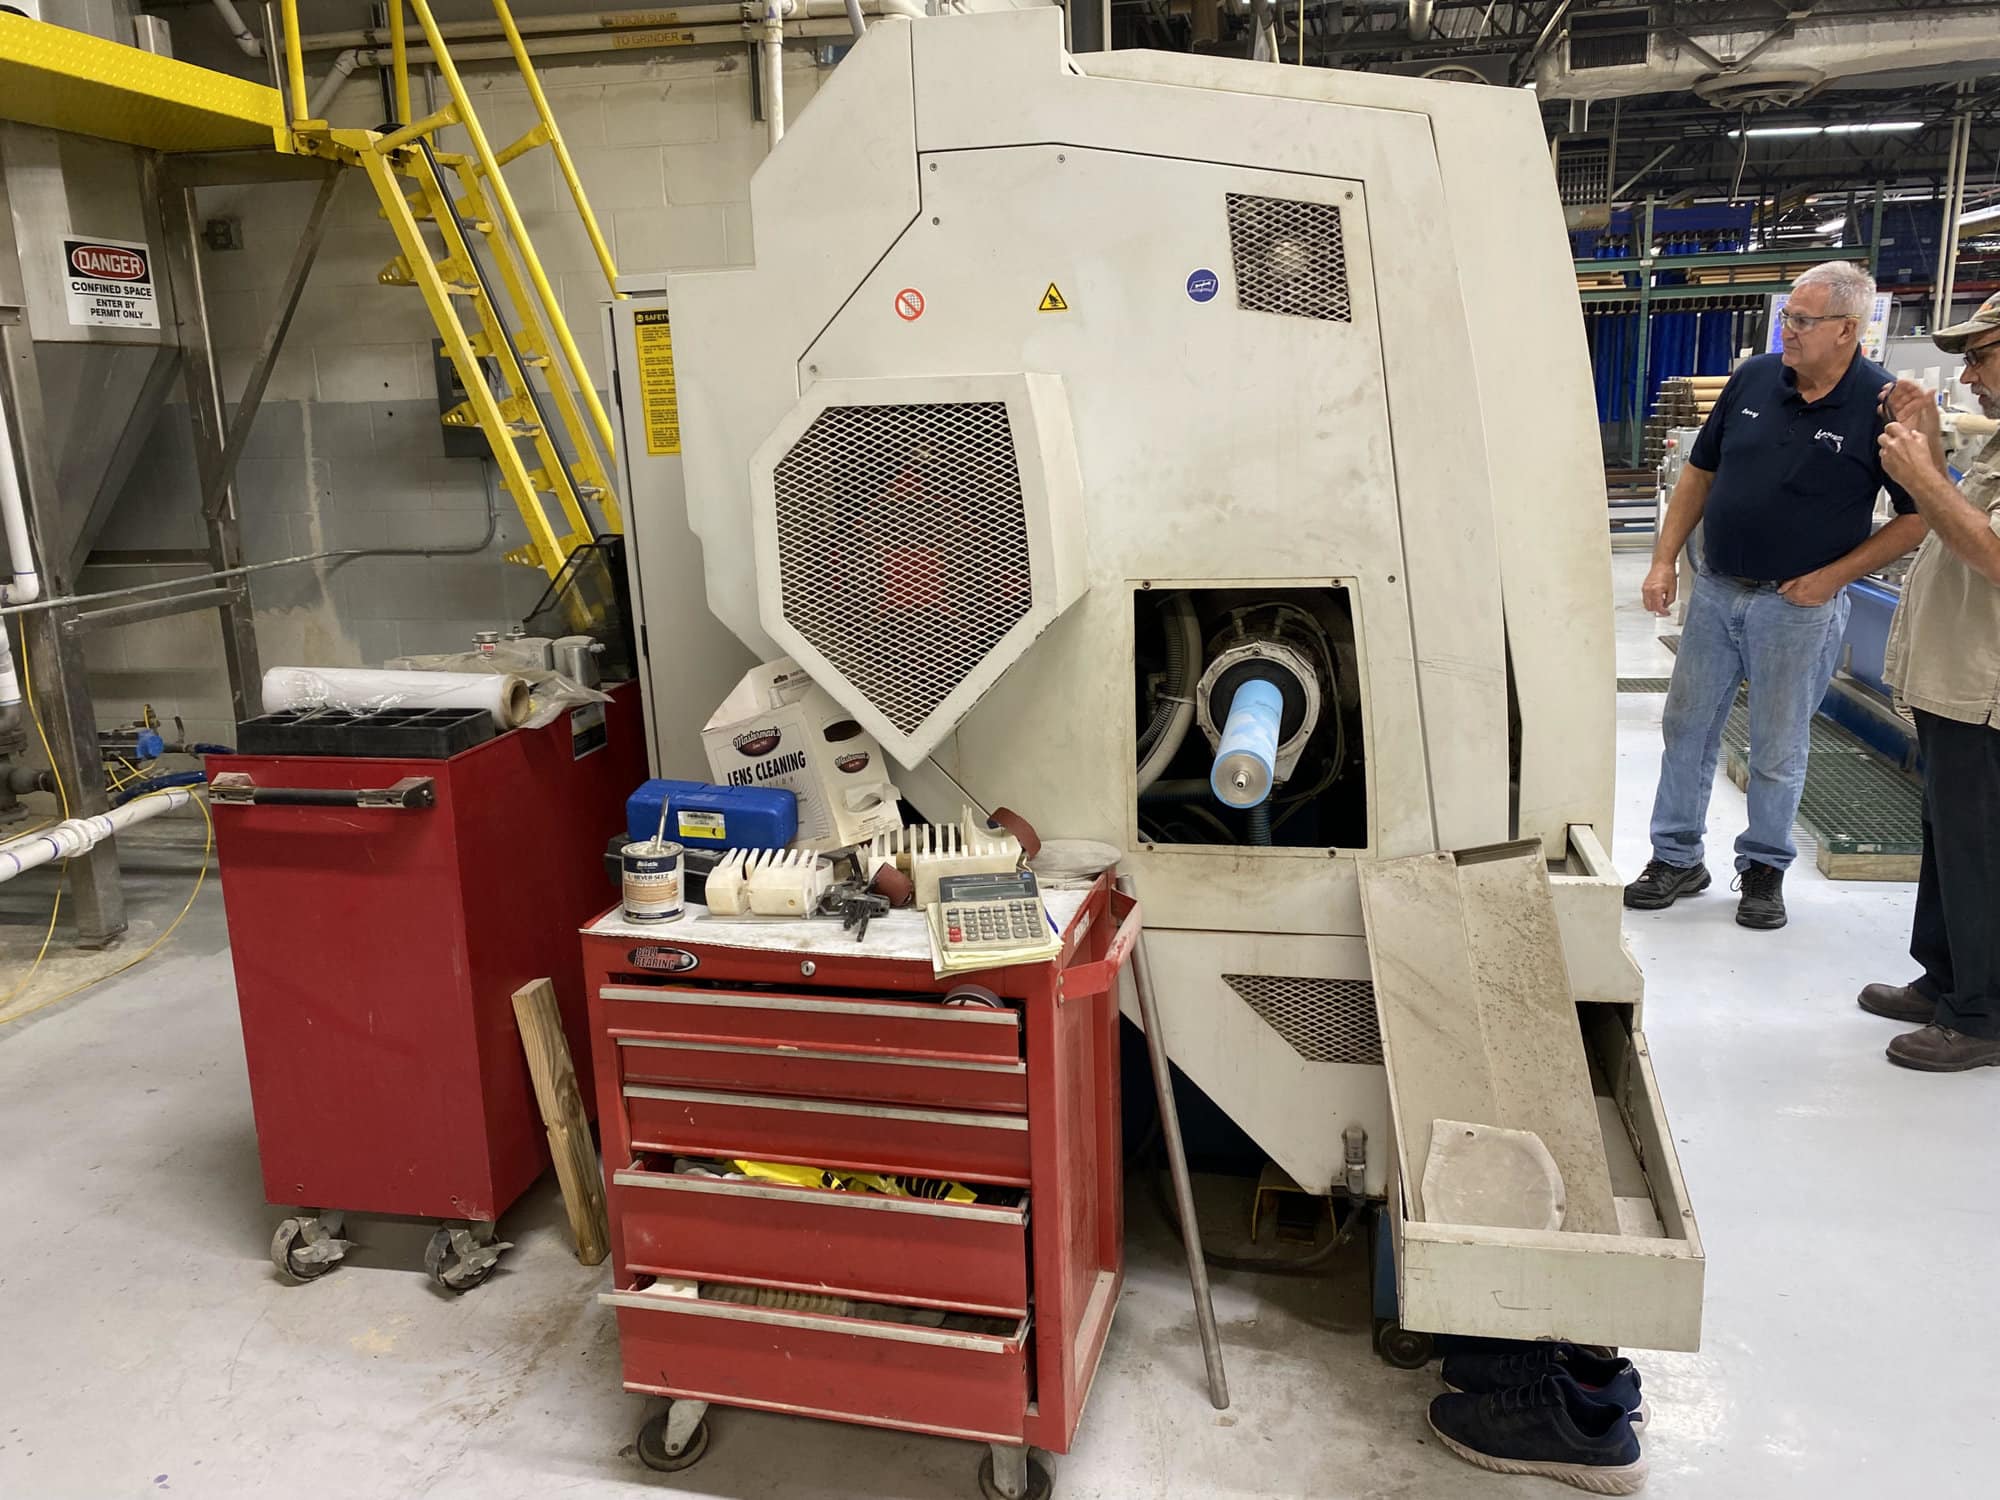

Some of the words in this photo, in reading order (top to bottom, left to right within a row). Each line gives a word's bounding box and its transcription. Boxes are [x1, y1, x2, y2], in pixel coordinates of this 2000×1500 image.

[616, 36, 630, 45] TO
[631, 31, 679, 44] GRINDER
[78, 250, 141, 275] DANGER
[71, 281, 121, 295] CONFINED
[123, 286, 152, 297] SPACE
[96, 298, 123, 309] ENTER
[125, 301, 136, 309] BY
[90, 308, 121, 318] PERMIT
[122, 310, 144, 319] ONLY
[727, 766, 753, 787] LENS
[755, 750, 806, 781] CLEANING
